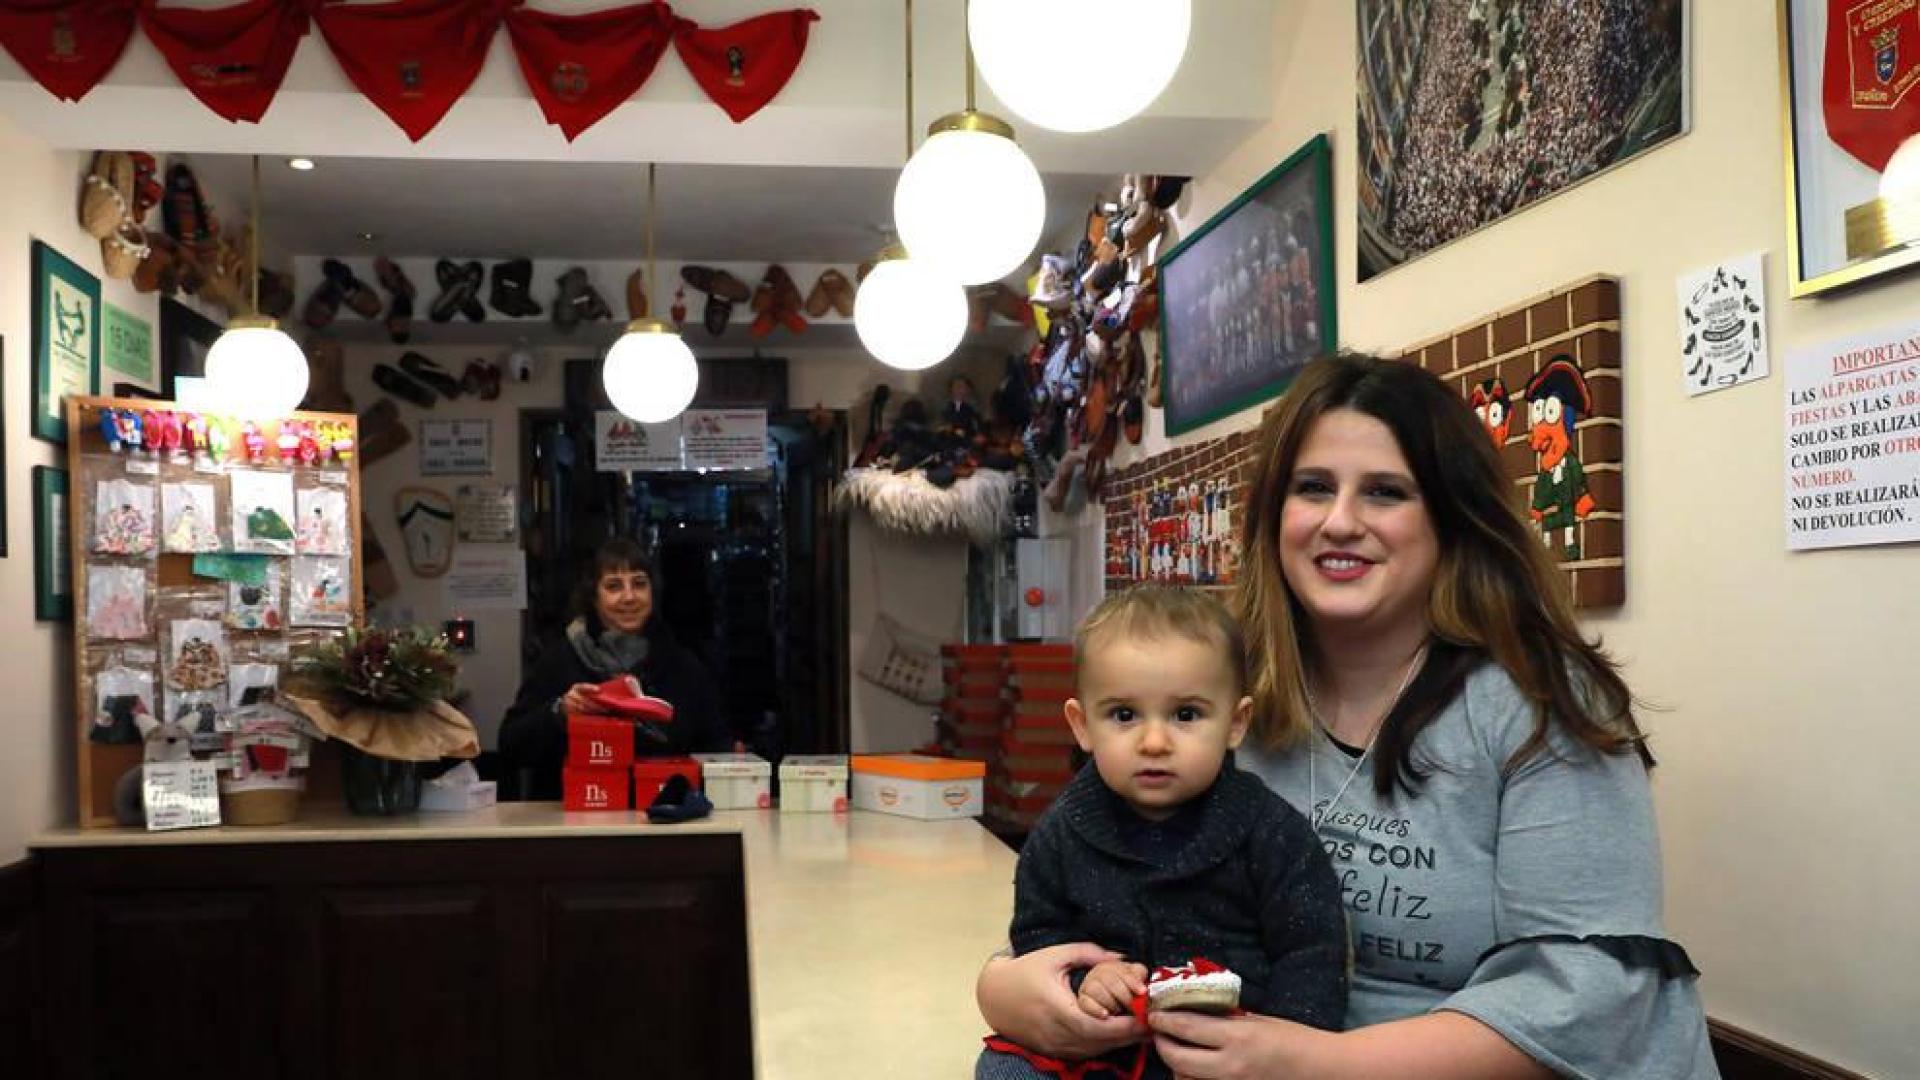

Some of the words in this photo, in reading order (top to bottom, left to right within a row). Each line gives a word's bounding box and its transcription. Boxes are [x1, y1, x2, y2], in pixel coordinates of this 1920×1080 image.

[1791, 387, 1816, 406] LAS
[1820, 366, 1918, 399] ALPARGATAS
[1791, 403, 1846, 427] FIESTAS
[1849, 401, 1861, 416] Y
[1863, 395, 1892, 415] LAS
[1790, 427, 1828, 448] SOLO
[1830, 425, 1848, 442] SE
[1851, 412, 1920, 439] REALIZA
[1791, 447, 1849, 469] CAMBIO
[1851, 442, 1881, 461] POR
[1883, 435, 1920, 456] OTR
[1791, 494, 1812, 511] NO
[1815, 493, 1832, 509] SE
[1835, 477, 1919, 507] REALIZARÁ
[1791, 516, 1807, 533] NI
[1810, 504, 1905, 531] DEVOLUCIÓN
[1368, 843, 1436, 870] CON
[1359, 933, 1445, 963] FELIZ
